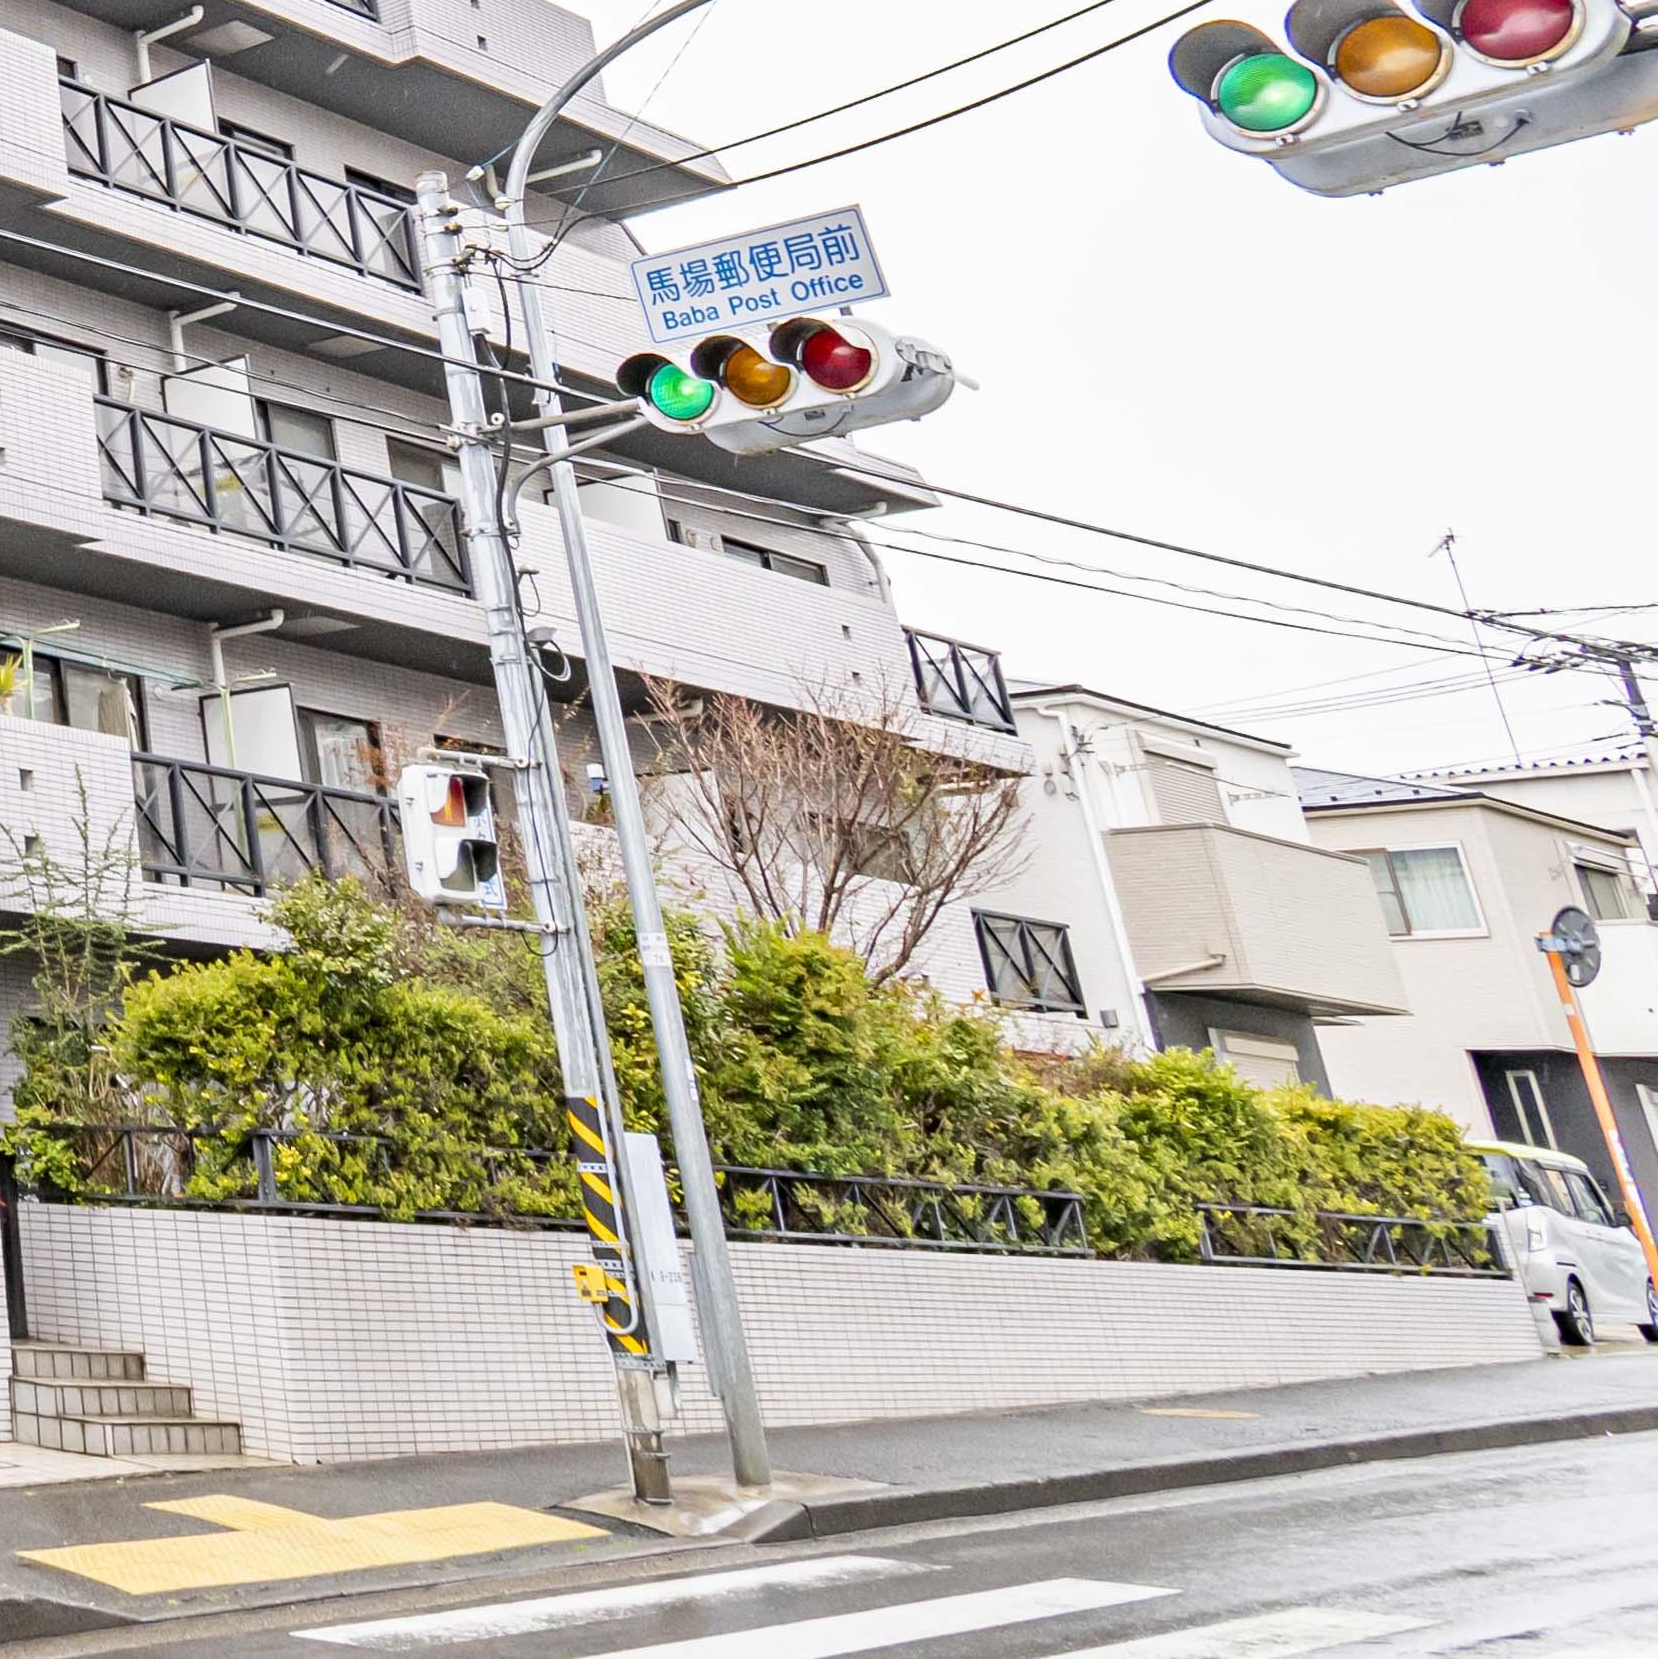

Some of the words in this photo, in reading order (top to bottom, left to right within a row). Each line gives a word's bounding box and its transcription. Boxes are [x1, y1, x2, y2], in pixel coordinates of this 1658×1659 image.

[645, 223, 861, 306] 馬場郵便局前
[661, 304, 720, 330] Baba
[728, 287, 781, 316] Post
[790, 273, 864, 302] Office
